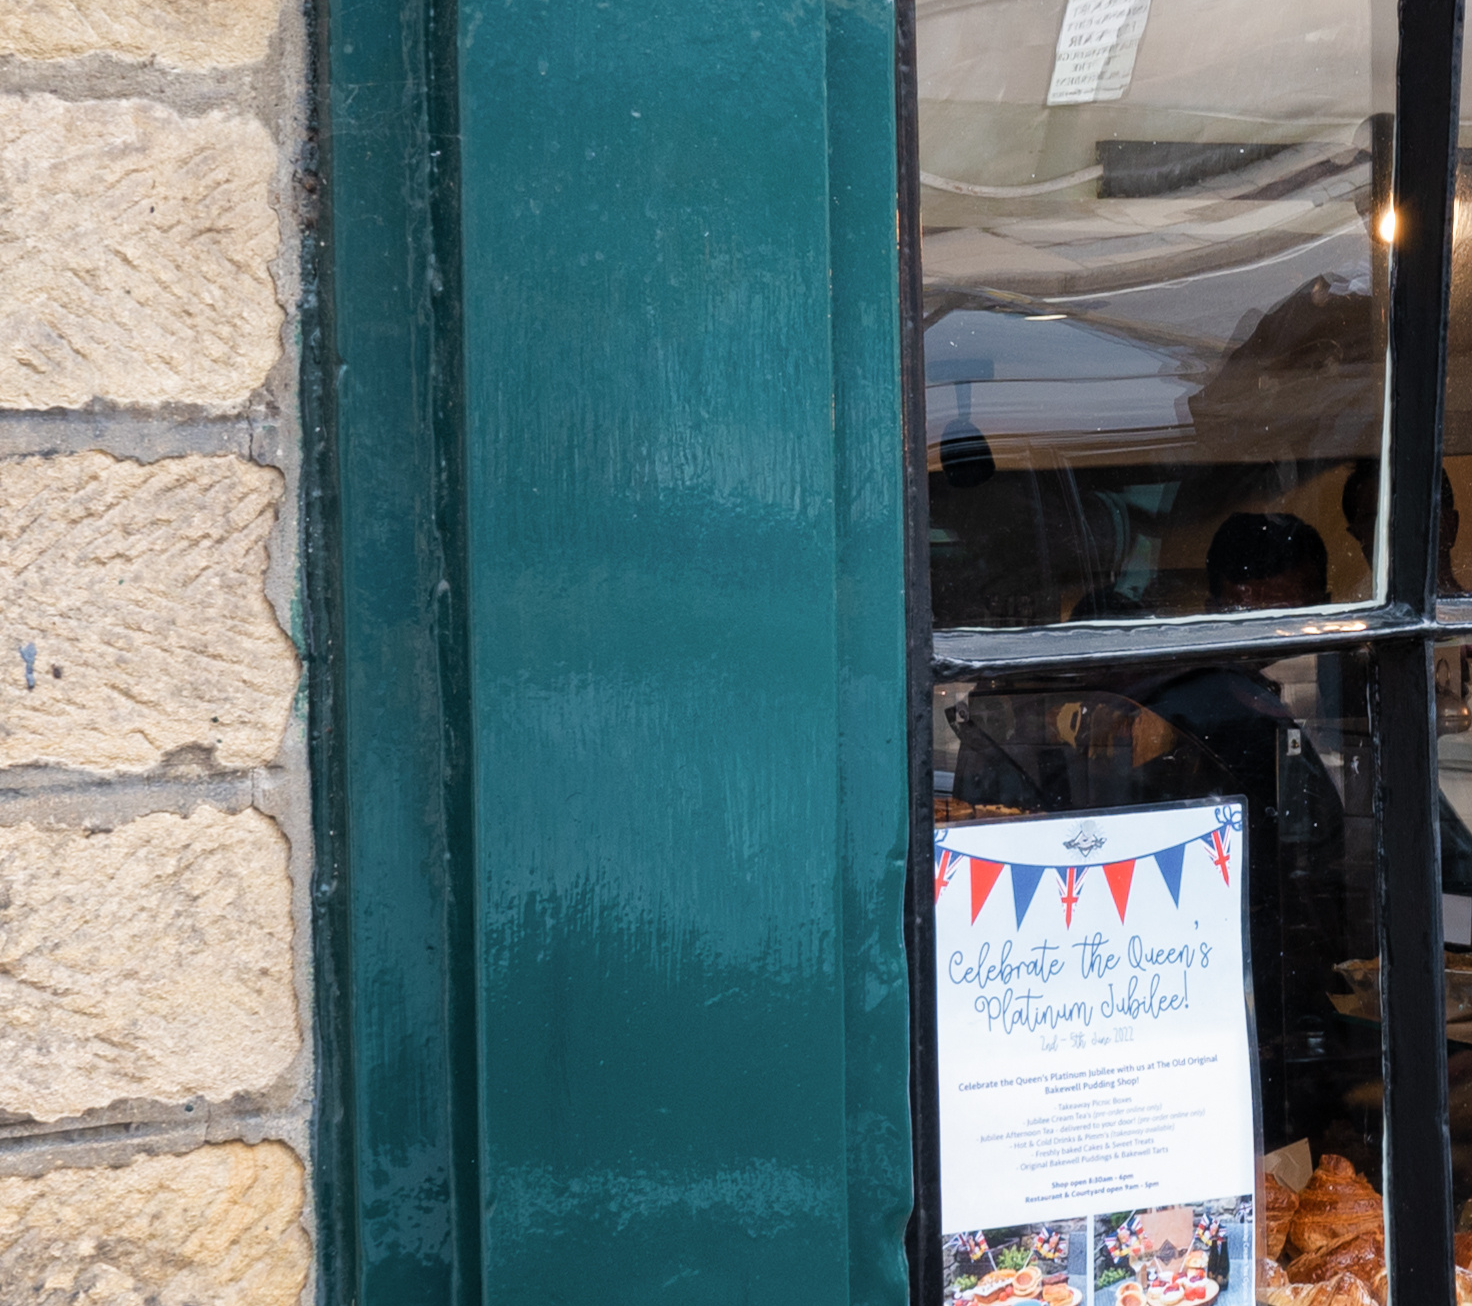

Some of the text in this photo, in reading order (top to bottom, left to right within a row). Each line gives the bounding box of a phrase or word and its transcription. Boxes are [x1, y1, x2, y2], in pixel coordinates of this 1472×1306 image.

[949, 920, 1213, 988] Celebrate the Queen's
[974, 970, 1189, 1034] Platinum Jubilee!
[958, 1080, 998, 1092] Celebrate
[1000, 1078, 1014, 1087] the
[1016, 1074, 1048, 1086] Queen's
[1050, 1071, 1087, 1081] Platinum
[1088, 1067, 1115, 1078] Jubilee
[1117, 1064, 1134, 1074] with
[1157, 1060, 1170, 1069] The
[1172, 1058, 1186, 1067] Old
[1188, 1054, 1218, 1066] Original
[1045, 1076, 1139, 1095] Bakewell Pudding Shop!
